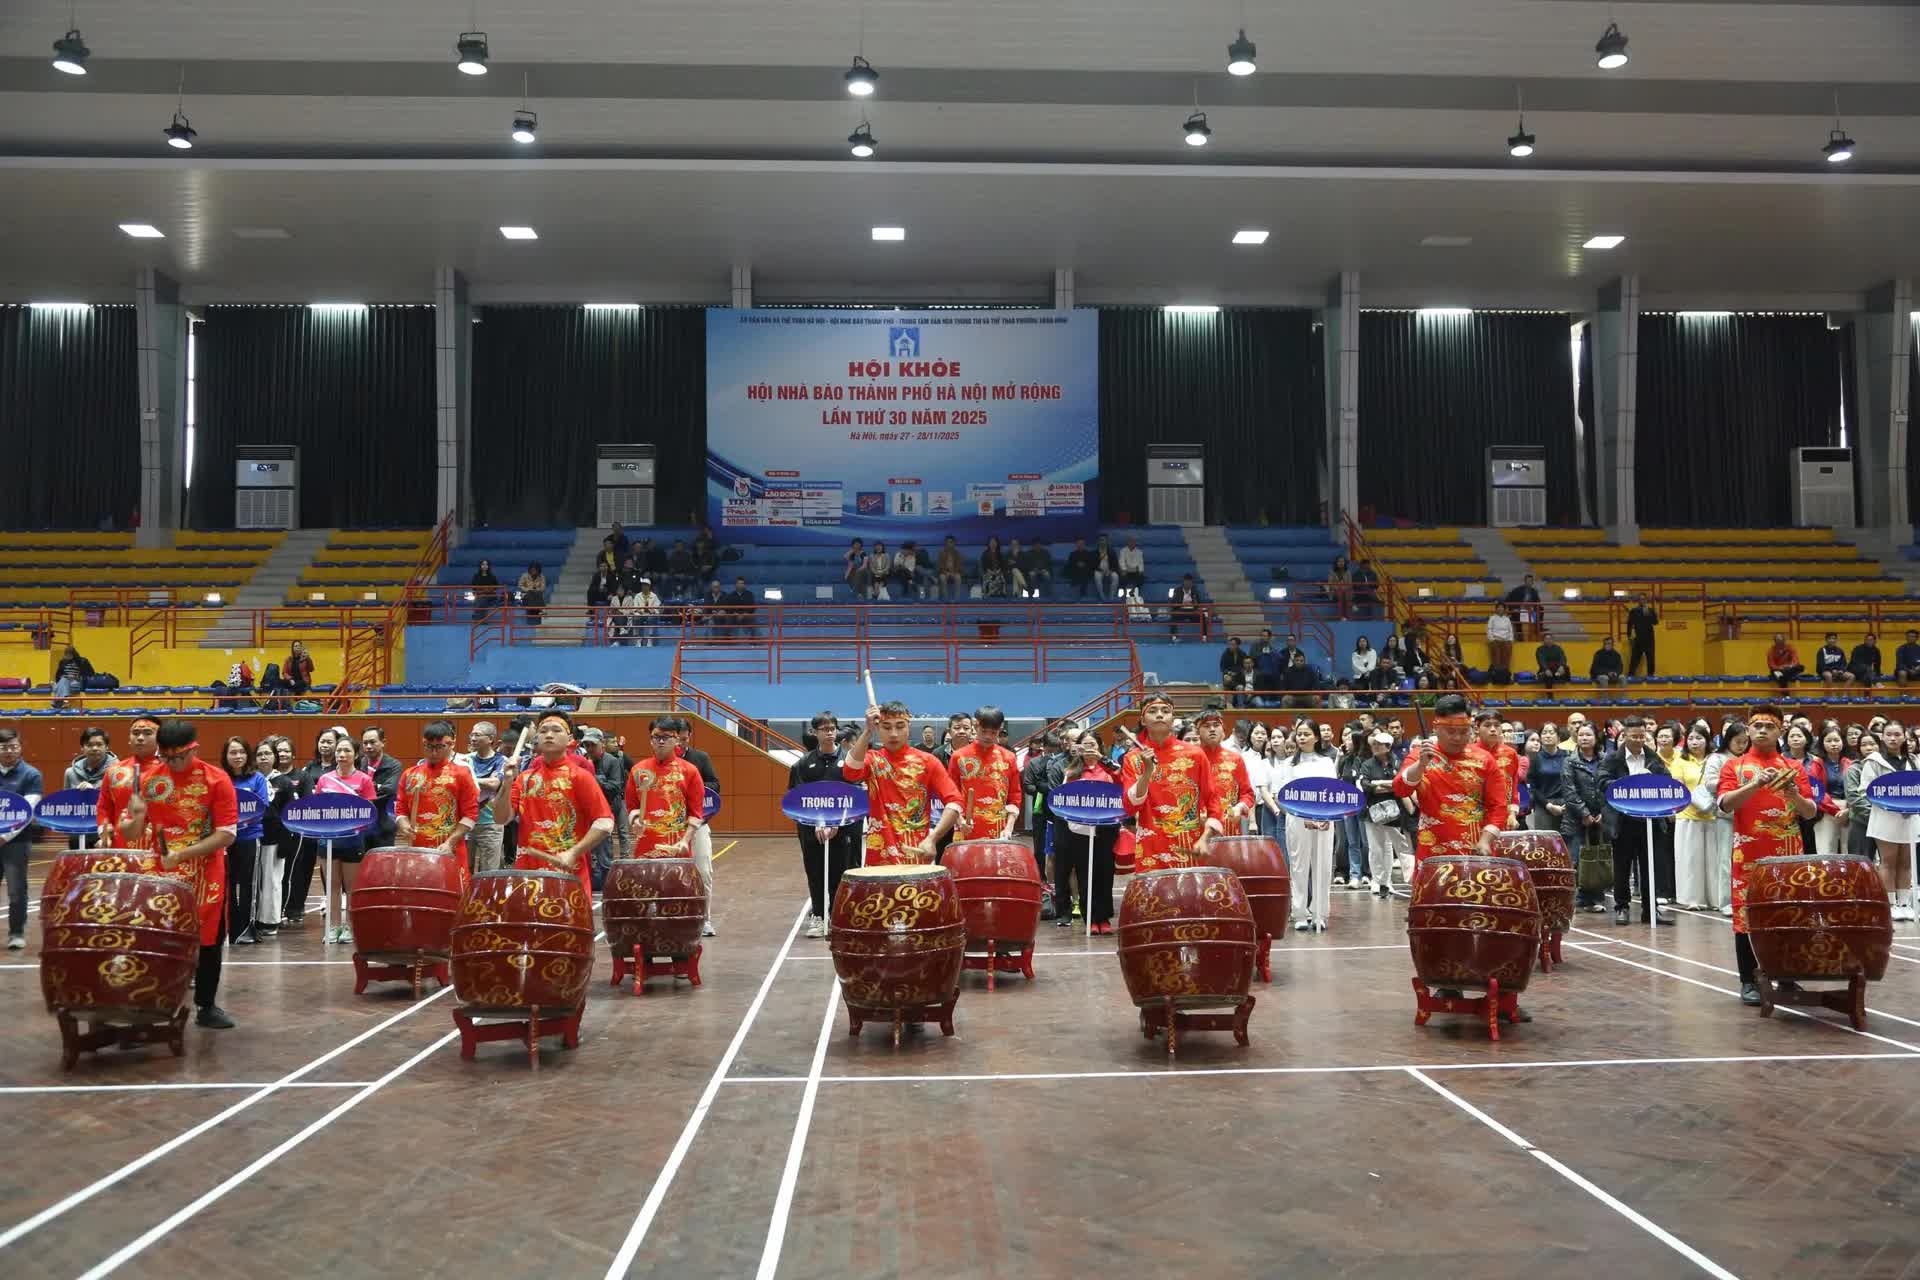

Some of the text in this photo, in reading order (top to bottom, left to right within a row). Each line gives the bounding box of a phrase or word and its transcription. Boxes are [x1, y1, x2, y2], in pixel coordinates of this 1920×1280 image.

[848, 358, 960, 381] HỘI KHỎE
[748, 380, 1060, 403] HỘI NHÀ BÁO THÀNH PHỐ HÀ NỘI MỞ RỘNG
[856, 408, 886, 424] THỨ
[889, 411, 907, 424] 30
[912, 408, 946, 424] NĂM
[952, 411, 987, 424] 2025
[850, 432, 860, 440] Hà
[917, 432, 960, 440] 28/11/2025
[1285, 787, 1358, 806] BÁO KINH TẾ & ĐÔ THỊ
[1613, 785, 1684, 799] BÁO AN NINH THỦ ĐÔ
[1873, 783, 1920, 798] TẠP CHÍ NGƯỜ
[240, 801, 257, 813] NAY
[801, 795, 853, 810] TRỌNG TÀI
[1053, 793, 1064, 808] HỘI
[1066, 794, 1080, 807] NHÀ
[1081, 794, 1095, 807] BÁO
[1096, 794, 1107, 808] HẢI
[41, 803, 55, 816] BÁO
[56, 803, 73, 816] PHÁP
[74, 802, 89, 818] LUẬT
[288, 806, 372, 820] BÁO NÔNG THÔN NGÀY NAY
